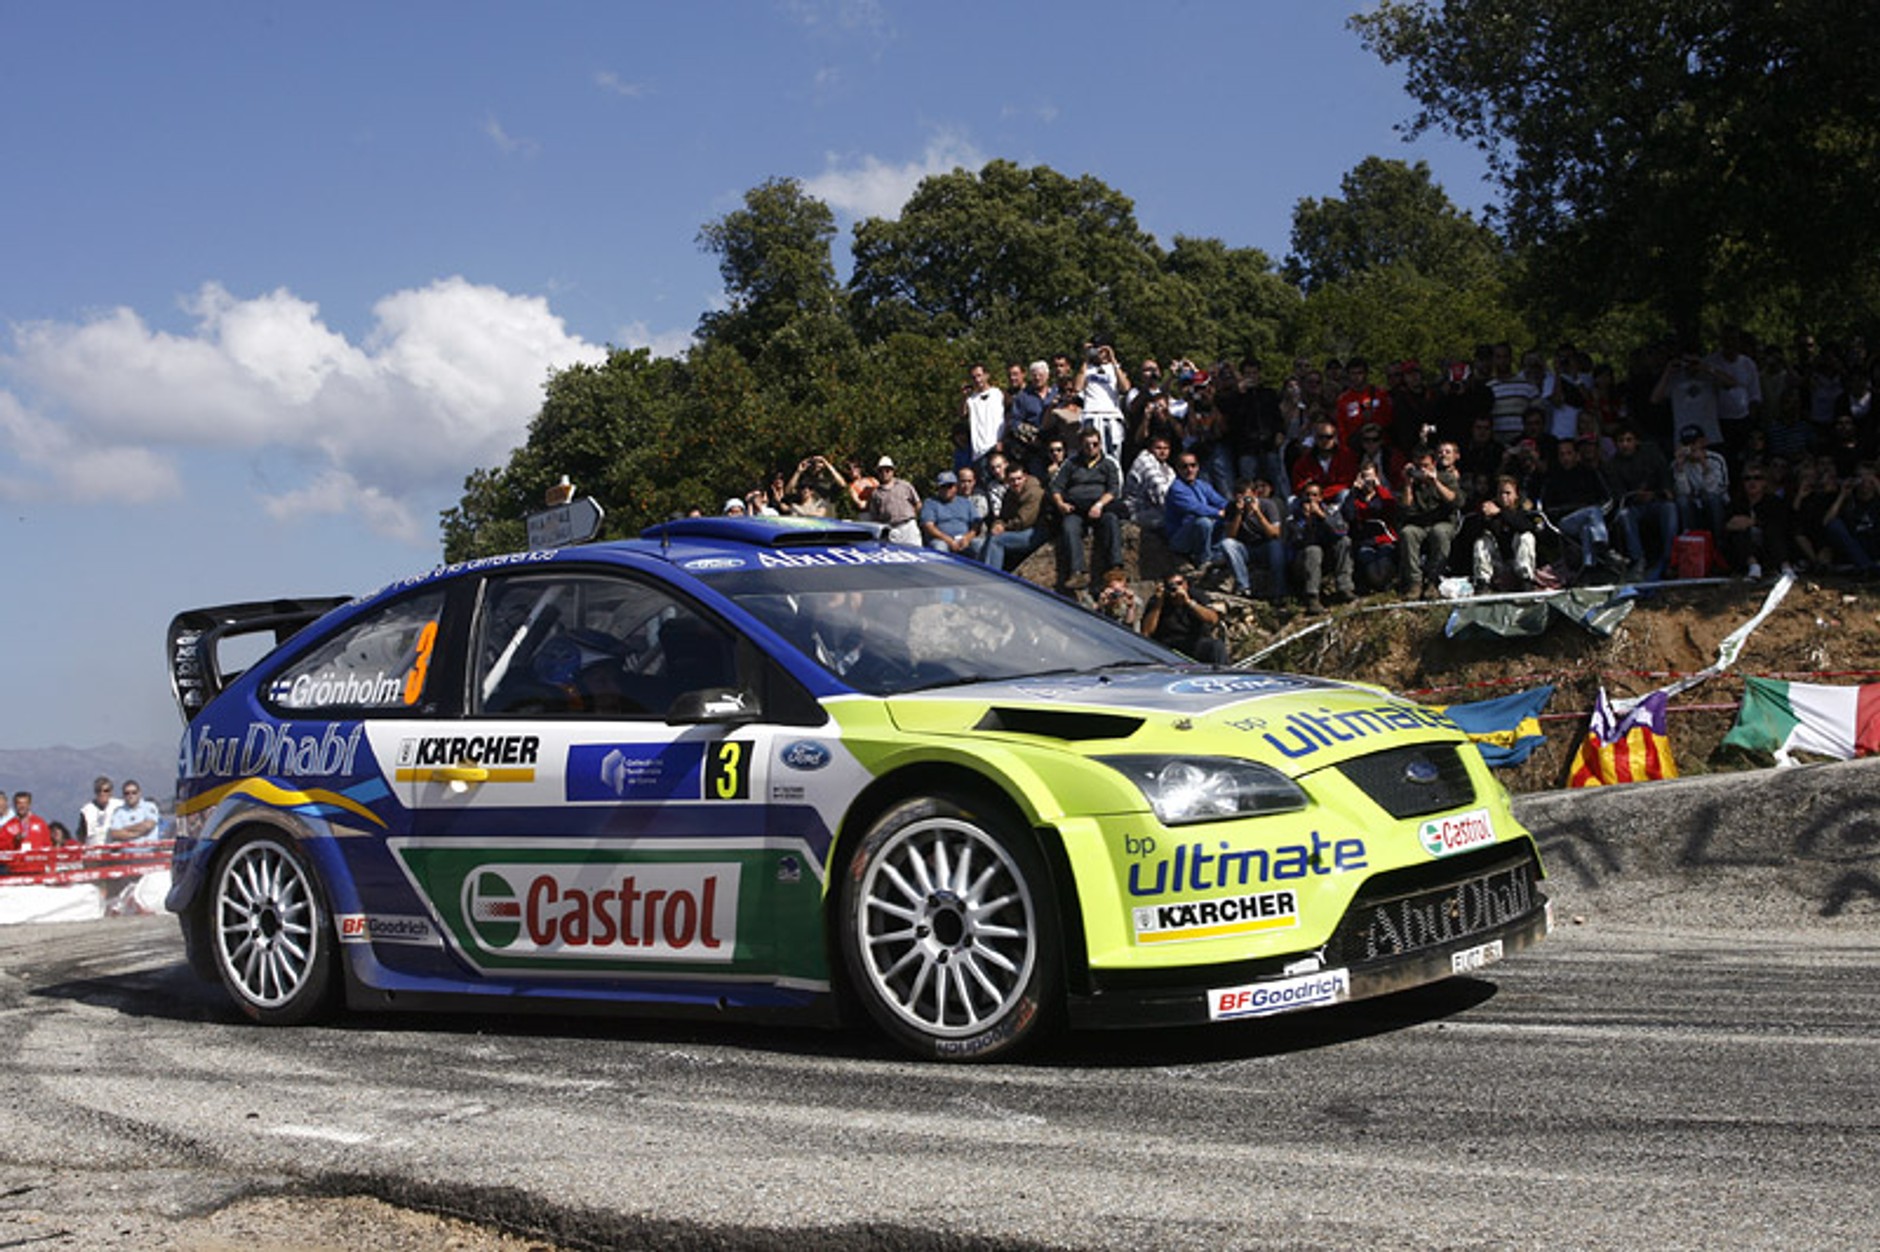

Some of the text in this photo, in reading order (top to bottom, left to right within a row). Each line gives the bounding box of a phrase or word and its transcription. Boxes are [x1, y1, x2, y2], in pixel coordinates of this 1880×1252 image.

[758, 550, 836, 568] Abu
[403, 620, 438, 705] 3
[290, 671, 401, 706] Grönholm
[1262, 700, 1460, 758] ultimate
[178, 726, 239, 778] Abu
[243, 722, 362, 777] Dhabi
[415, 736, 540, 765] KÄRCHER
[716, 742, 742, 799] 3
[1126, 834, 1156, 858] bp
[1443, 814, 1491, 848] Castrol
[1129, 831, 1368, 896] ultimate
[527, 874, 720, 950] Castrol
[1158, 891, 1295, 927] KÄRCHER
[1218, 976, 1343, 1011] BFGoodrich
